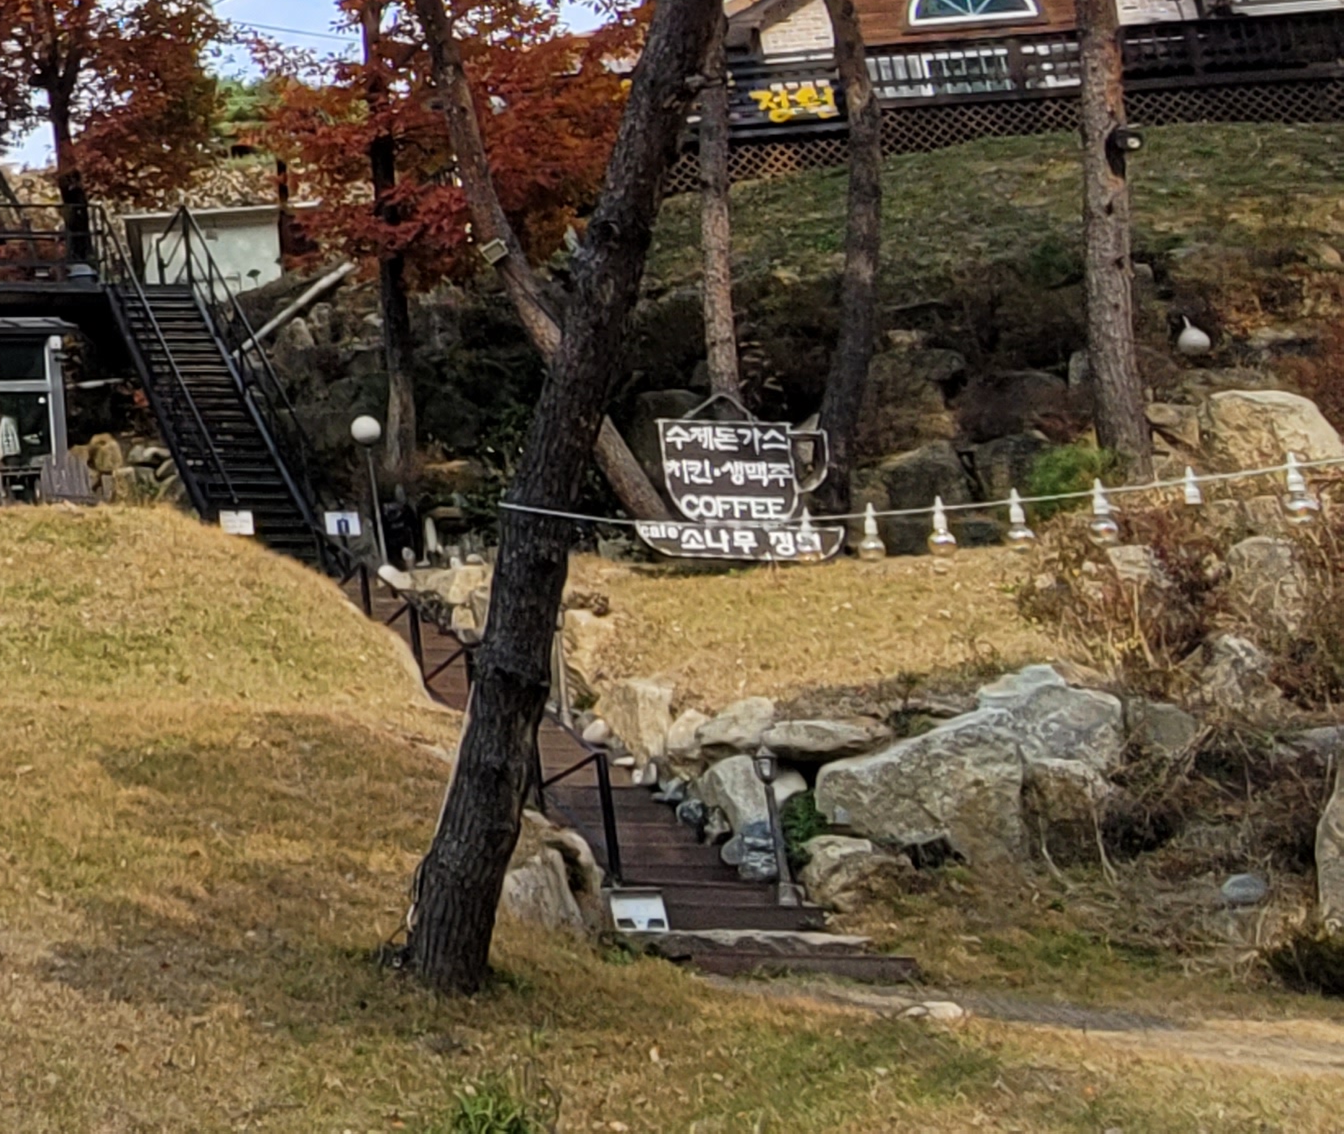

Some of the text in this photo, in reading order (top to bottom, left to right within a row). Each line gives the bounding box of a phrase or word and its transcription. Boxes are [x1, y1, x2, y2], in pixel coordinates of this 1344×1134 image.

[665, 425, 789, 455] 수제돈가스
[680, 494, 786, 520] COFFEE
[681, 528, 758, 554] 소나무
